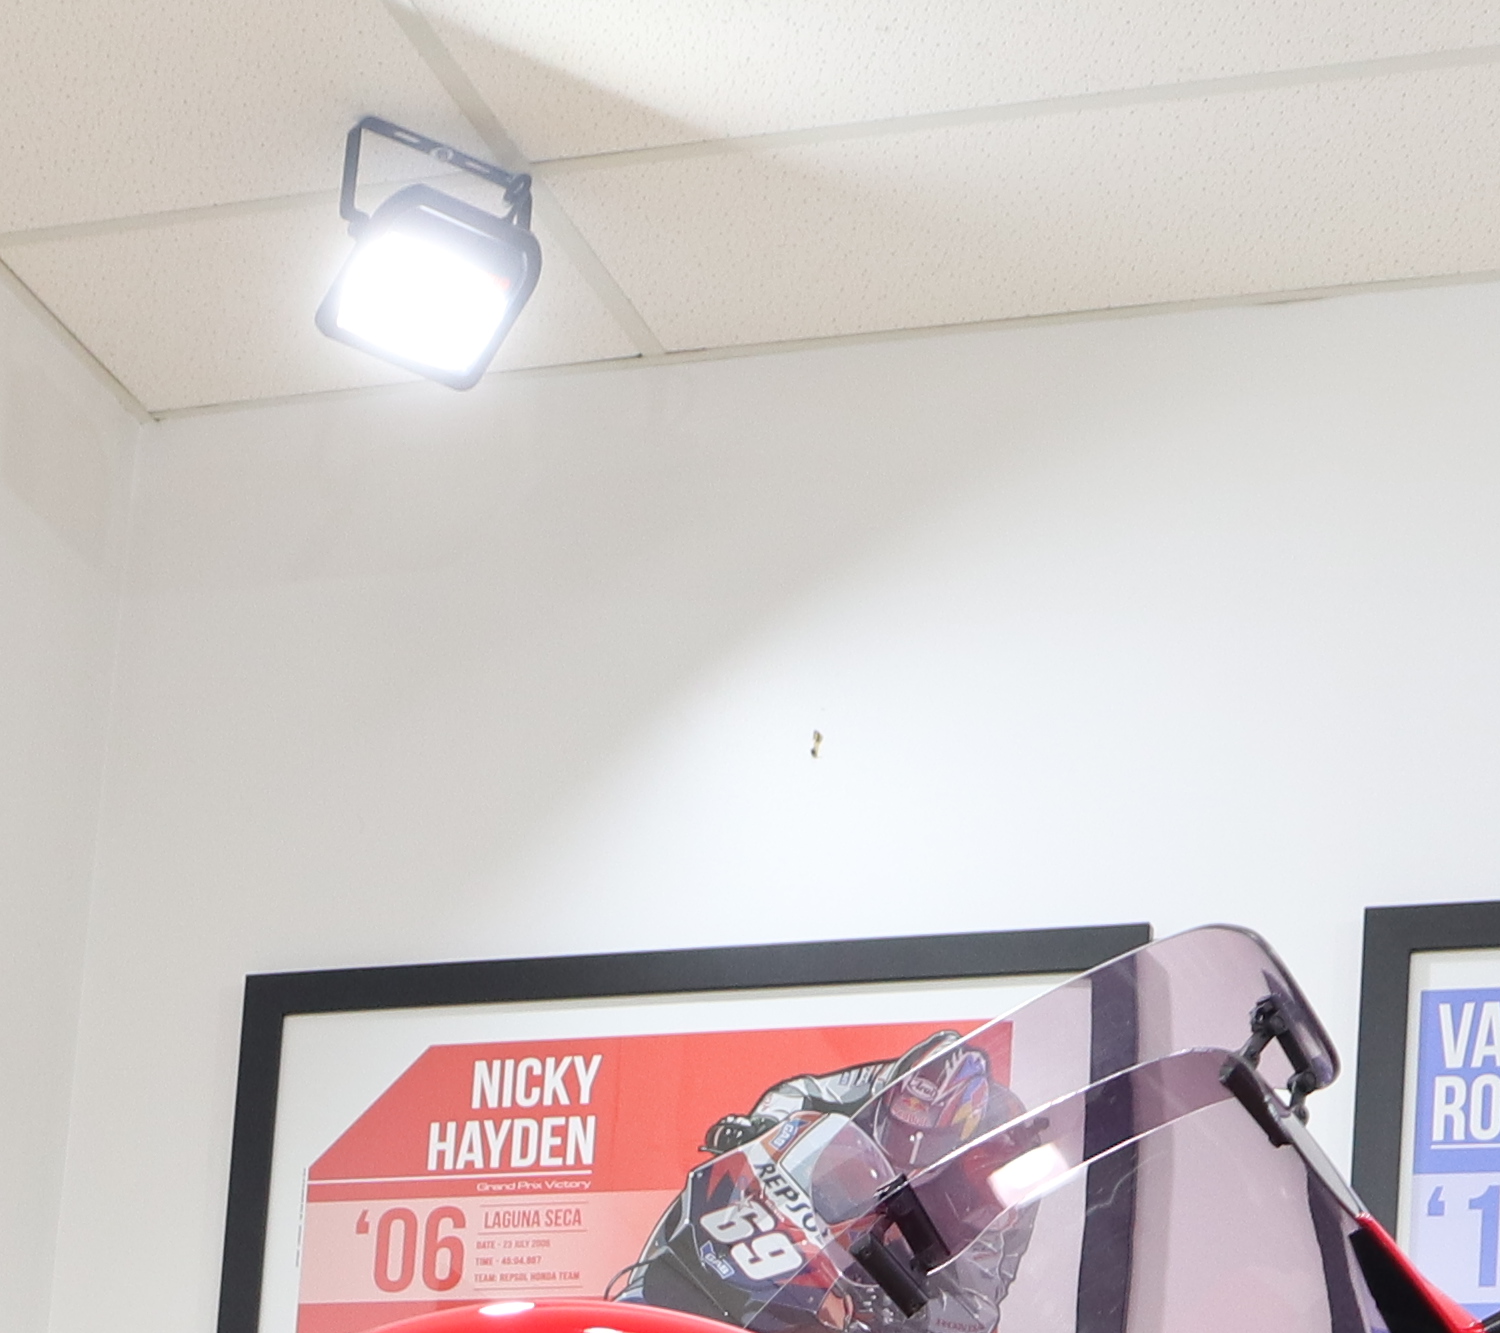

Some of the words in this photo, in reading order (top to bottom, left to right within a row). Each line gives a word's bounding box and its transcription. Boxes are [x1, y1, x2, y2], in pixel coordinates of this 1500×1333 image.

[471, 1054, 602, 1109] NICKY
[426, 1115, 596, 1171] HAYDEN
[476, 1182, 515, 1192] Grand
[517, 1181, 542, 1191] Prix
[544, 1180, 592, 1192] Victory
[484, 1210, 541, 1229] LAGUNA
[544, 1208, 582, 1227] SECA
[476, 1240, 495, 1249] DATE
[700, 1201, 804, 1281] 69
